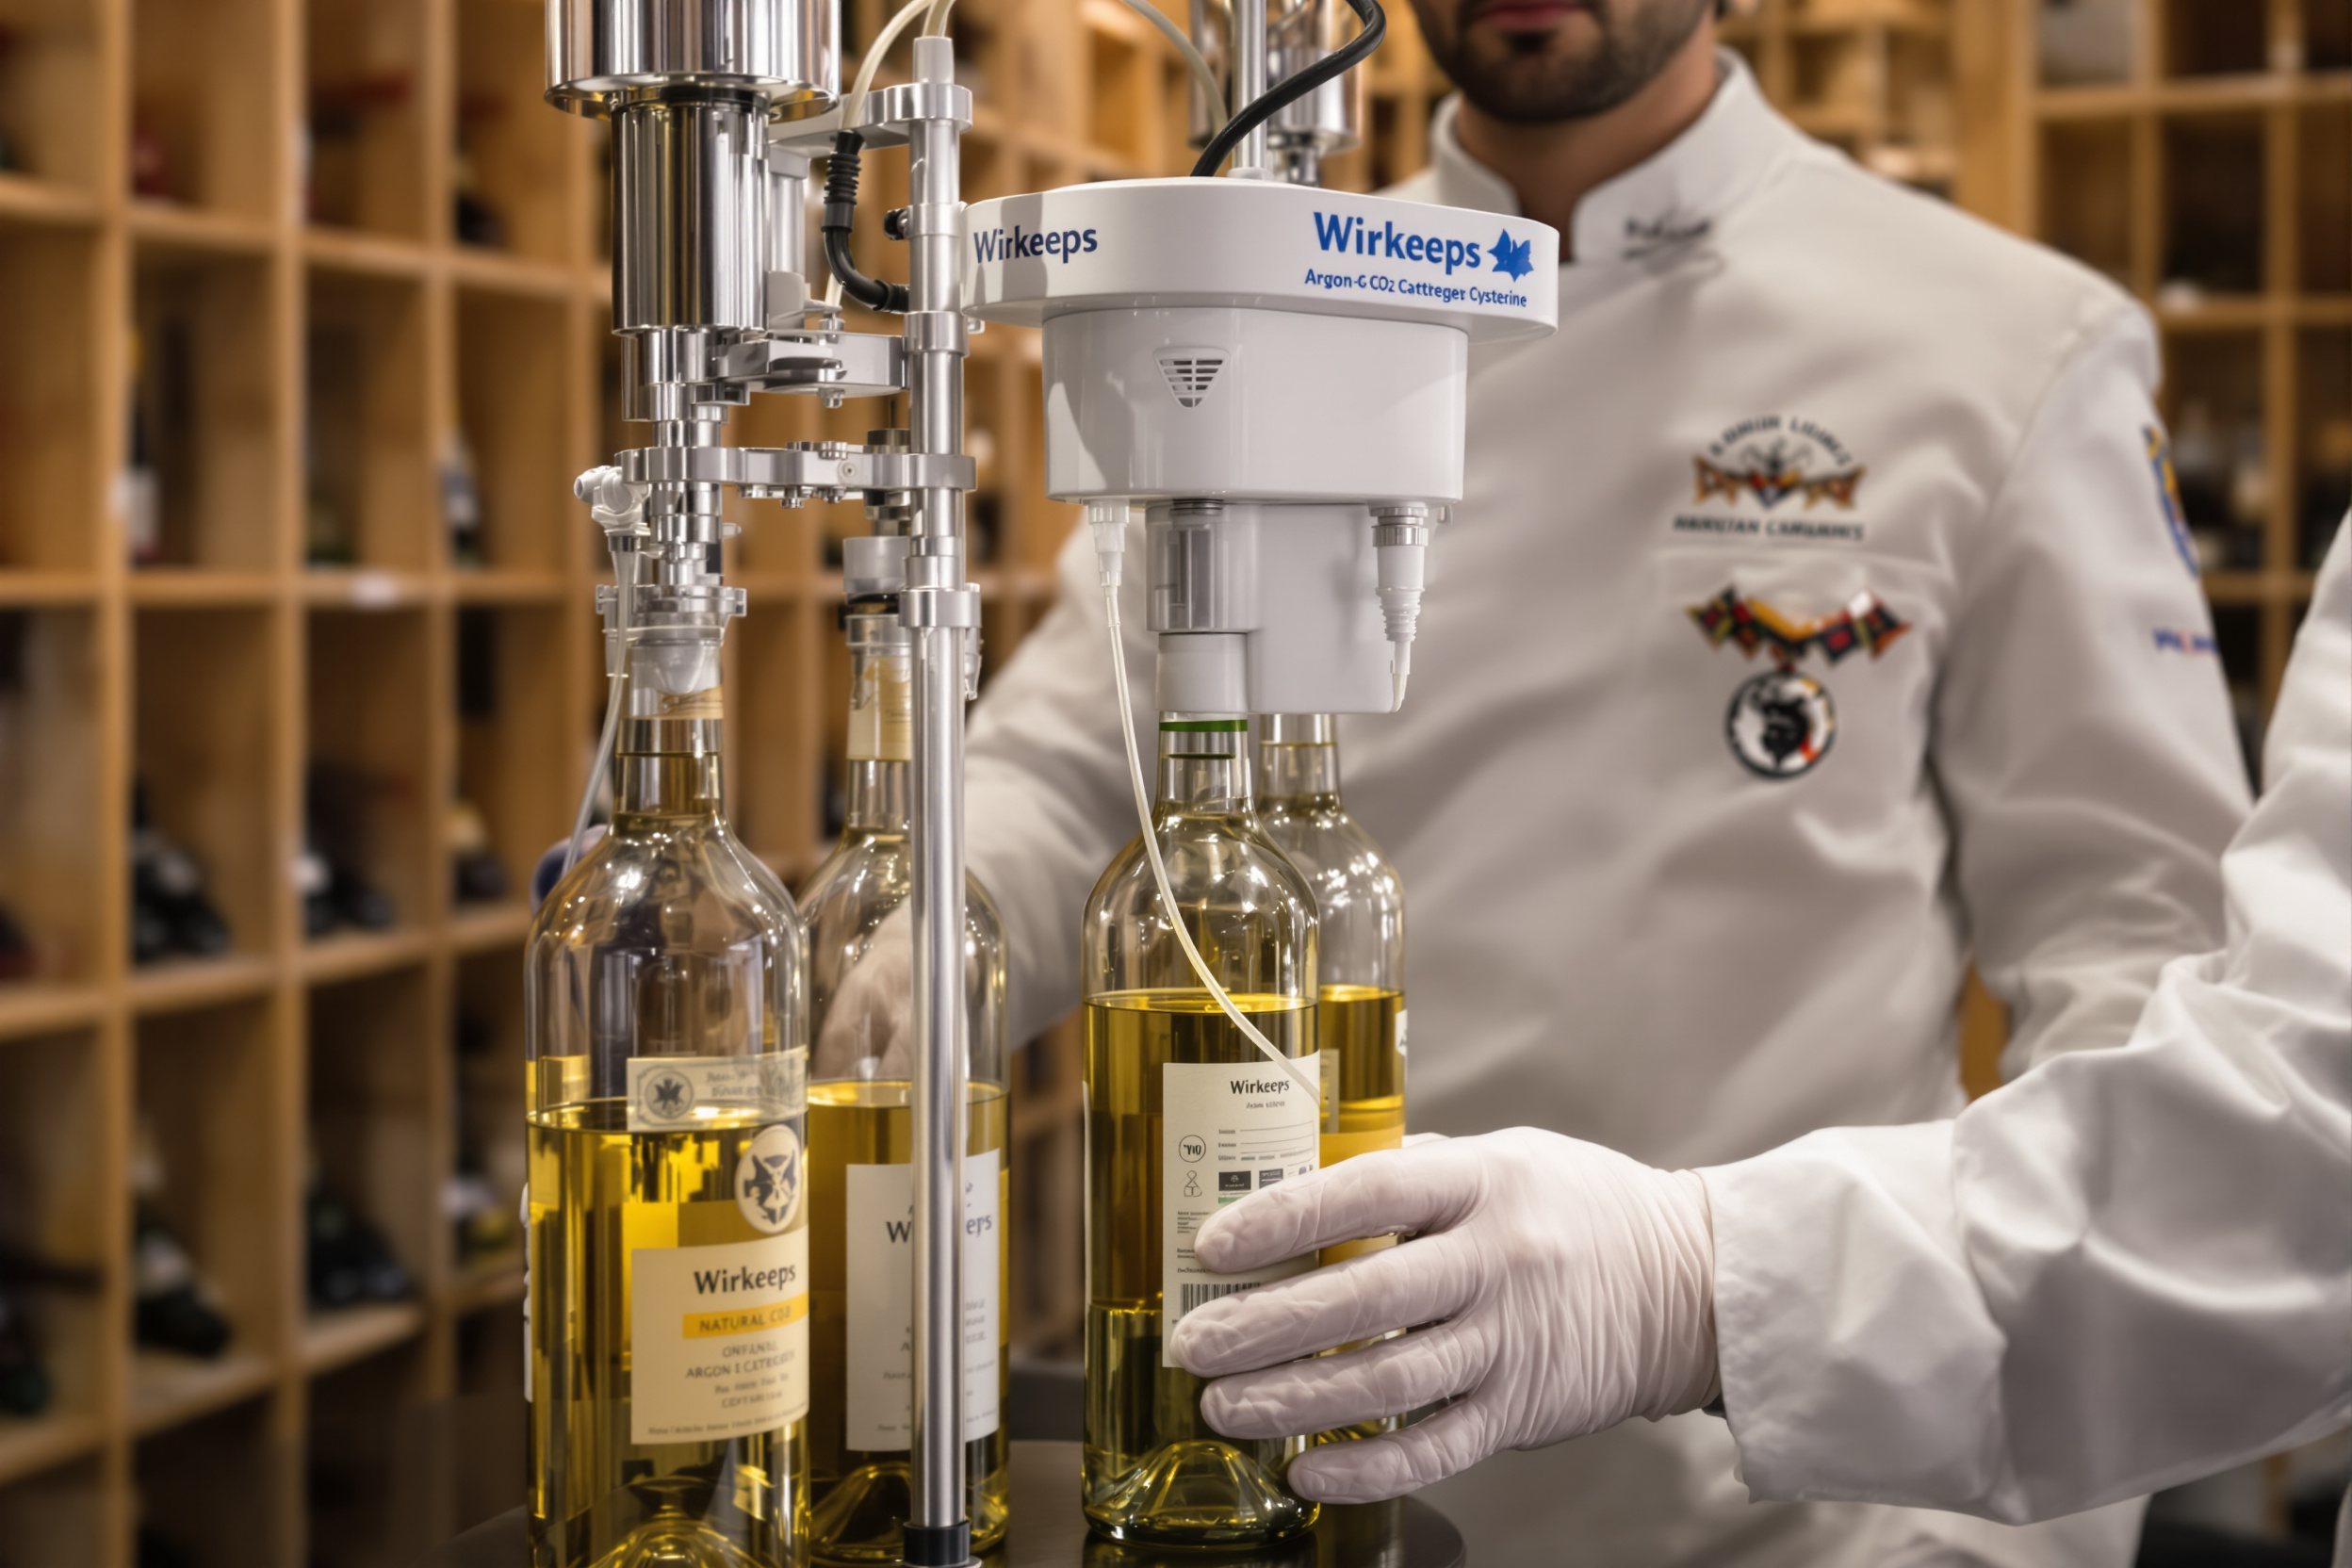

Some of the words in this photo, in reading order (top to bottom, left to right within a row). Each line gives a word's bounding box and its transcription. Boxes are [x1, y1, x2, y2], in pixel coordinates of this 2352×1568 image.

[973, 225, 1098, 264] Wirkeeps
[1314, 212, 1481, 275] Wirkeeps
[1469, 286, 1527, 307] Cysterine
[1231, 1080, 1290, 1094] Wirkeeps
[694, 1265, 795, 1295] Wirkeeps
[699, 1315, 765, 1332] NATURAL
